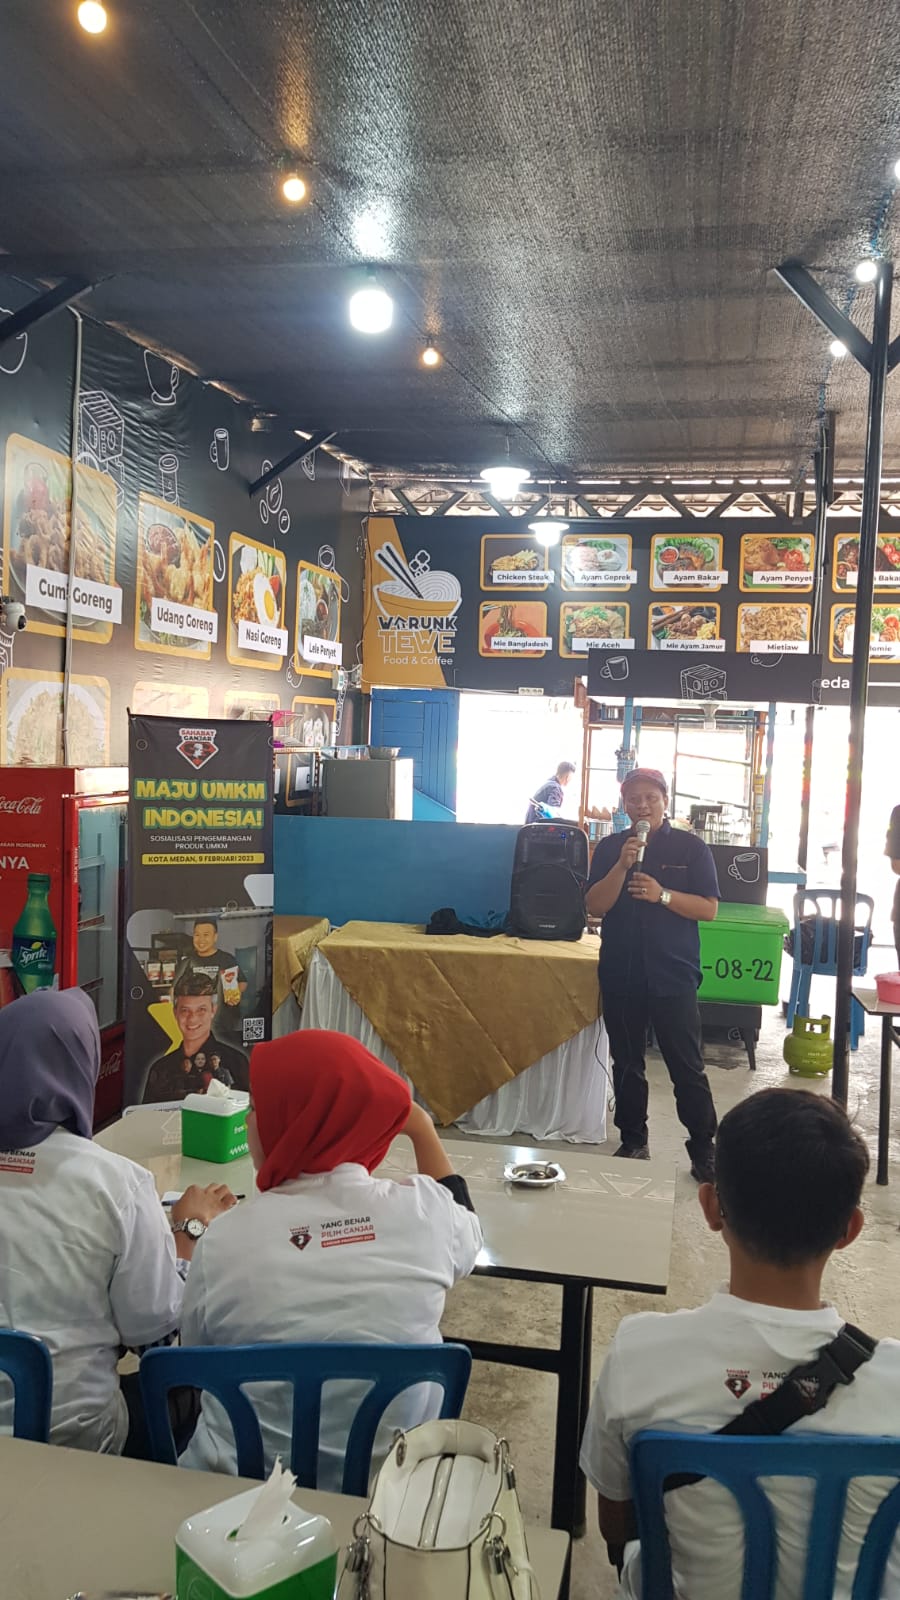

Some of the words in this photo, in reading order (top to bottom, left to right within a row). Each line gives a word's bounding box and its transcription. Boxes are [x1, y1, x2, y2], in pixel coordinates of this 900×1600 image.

[497, 573, 527, 582] Chicken
[528, 573, 550, 582] Steak
[581, 574, 602, 583] Ayam
[604, 574, 631, 583] Geprek
[673, 574, 695, 583] Ayam
[697, 574, 720, 582] Bakar
[760, 574, 783, 583] Ayam
[785, 574, 812, 583] Penyet
[878, 574, 900, 582] Baka
[72, 587, 113, 614] Goreng
[157, 606, 184, 629] Udang
[186, 613, 213, 635] Goreng
[377, 616, 457, 631] WARUNK
[246, 627, 260, 641] Nasi
[260, 631, 282, 649] Goreng
[378, 629, 456, 654] TEWE
[493, 639, 506, 648] Mie
[507, 639, 549, 650] Bangladesh
[586, 640, 599, 649] Mie
[602, 640, 620, 649] Aceh
[680, 643, 699, 651] Ayam
[767, 643, 799, 651] Mietiaw
[308, 642, 320, 654] Lele
[320, 644, 337, 659] Penyet
[383, 655, 409, 665] Food
[411, 655, 419, 665] &
[421, 655, 453, 665] Coffee
[136, 779, 199, 800] MAJU
[201, 780, 266, 801] UMKM
[144, 807, 264, 828] INDONESIA!
[22, 948, 48, 964] Sprite
[320, 1220, 343, 1230] YANG
[344, 1216, 371, 1226] BENAR
[321, 1229, 342, 1238] PILIH
